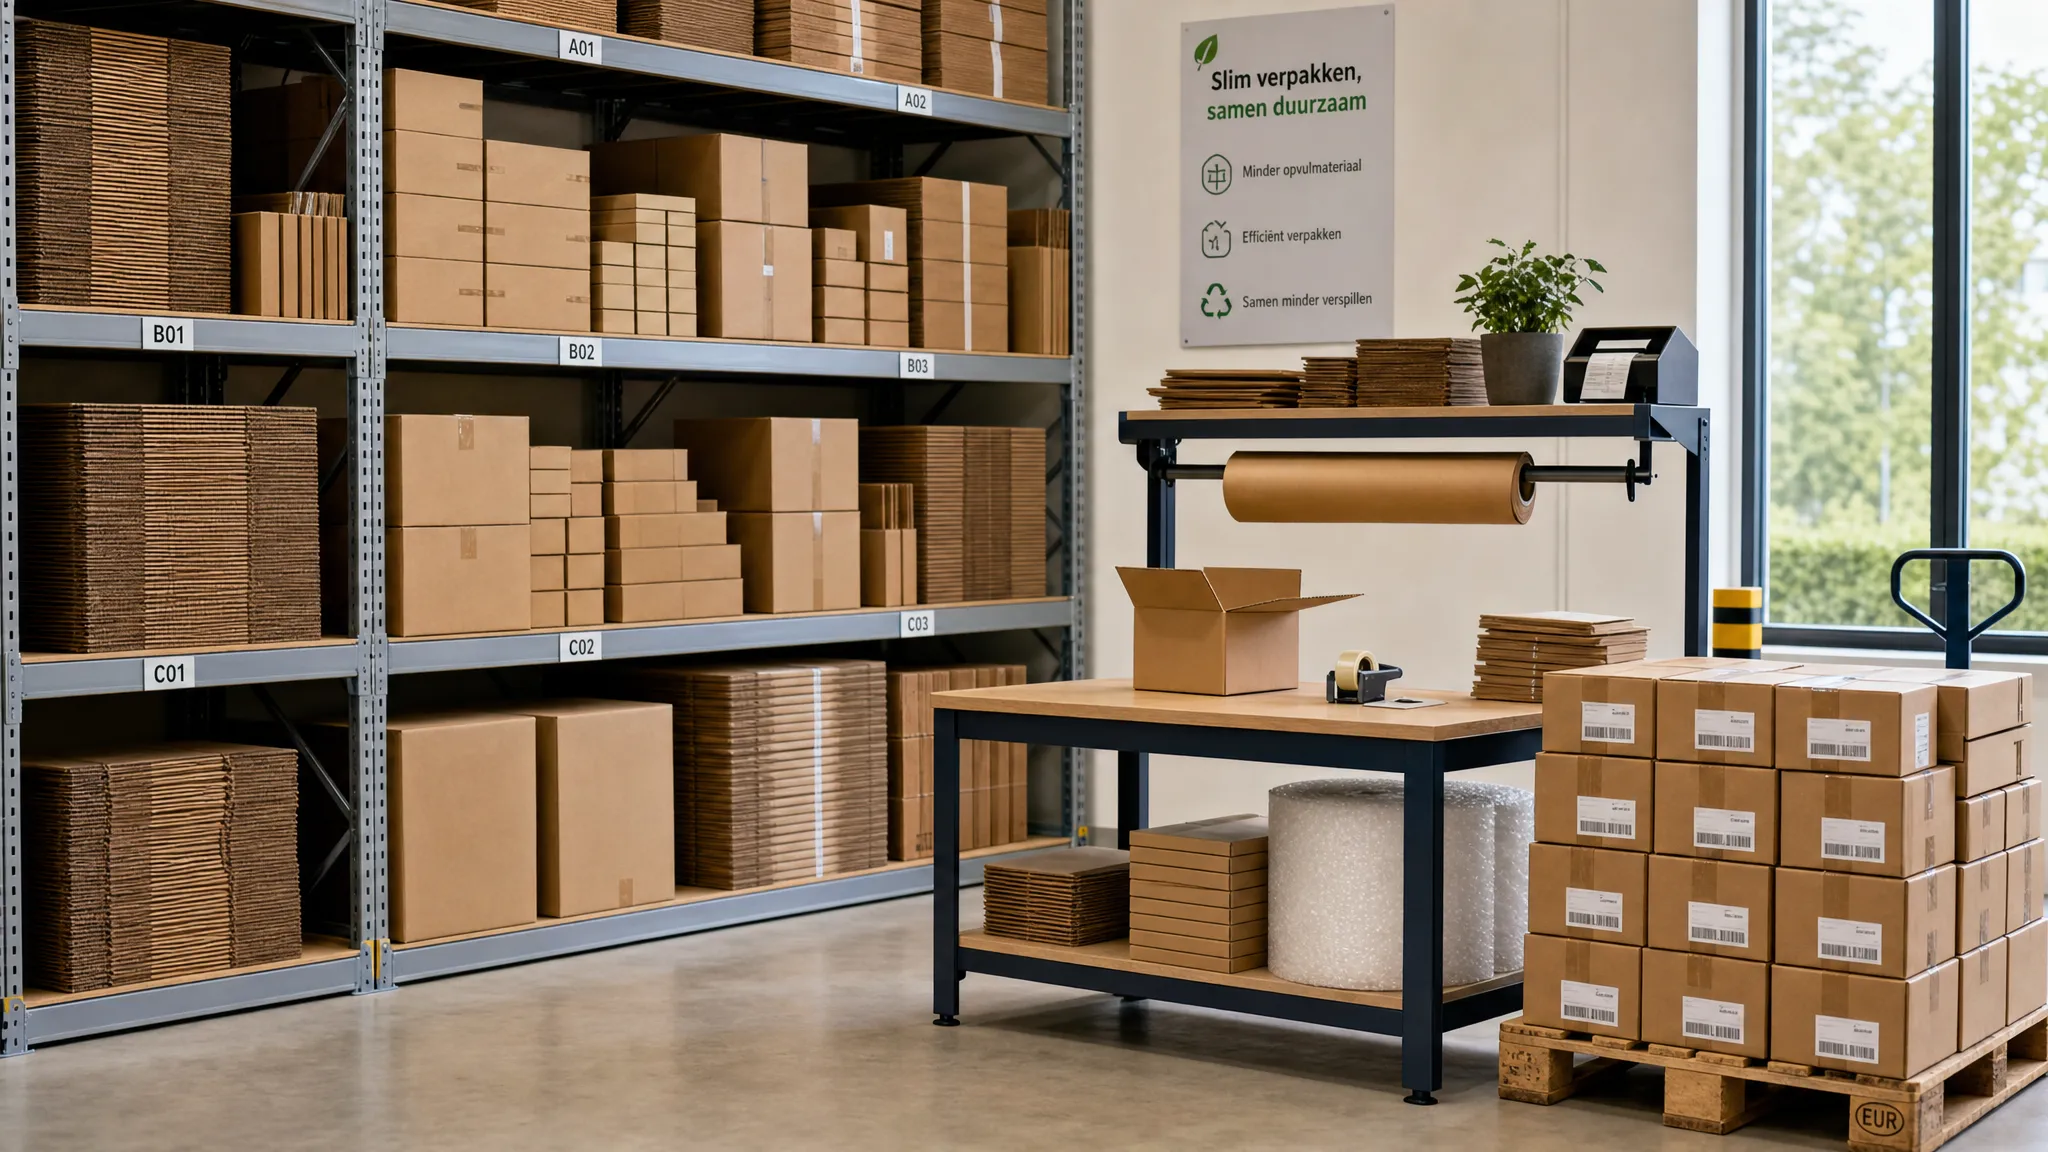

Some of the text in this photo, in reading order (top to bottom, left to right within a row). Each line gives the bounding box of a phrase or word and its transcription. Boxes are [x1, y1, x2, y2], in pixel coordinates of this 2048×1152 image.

[568, 38, 594, 58] A01
[1211, 62, 1362, 91] Slim verpakken,
[904, 92, 927, 110] A02
[1207, 94, 1367, 121] samen duurzaam
[1242, 158, 1362, 179] Minder opvulmateriaal
[1286, 227, 1342, 245] verpakken
[1242, 291, 1373, 309] Samen minder verspillen
[153, 324, 184, 344] B01
[569, 343, 595, 361] B02
[907, 358, 929, 374] B03
[907, 615, 929, 632] C03
[568, 638, 595, 656] C02
[154, 663, 184, 684] C01
[1862, 1107, 1897, 1130] EUR
